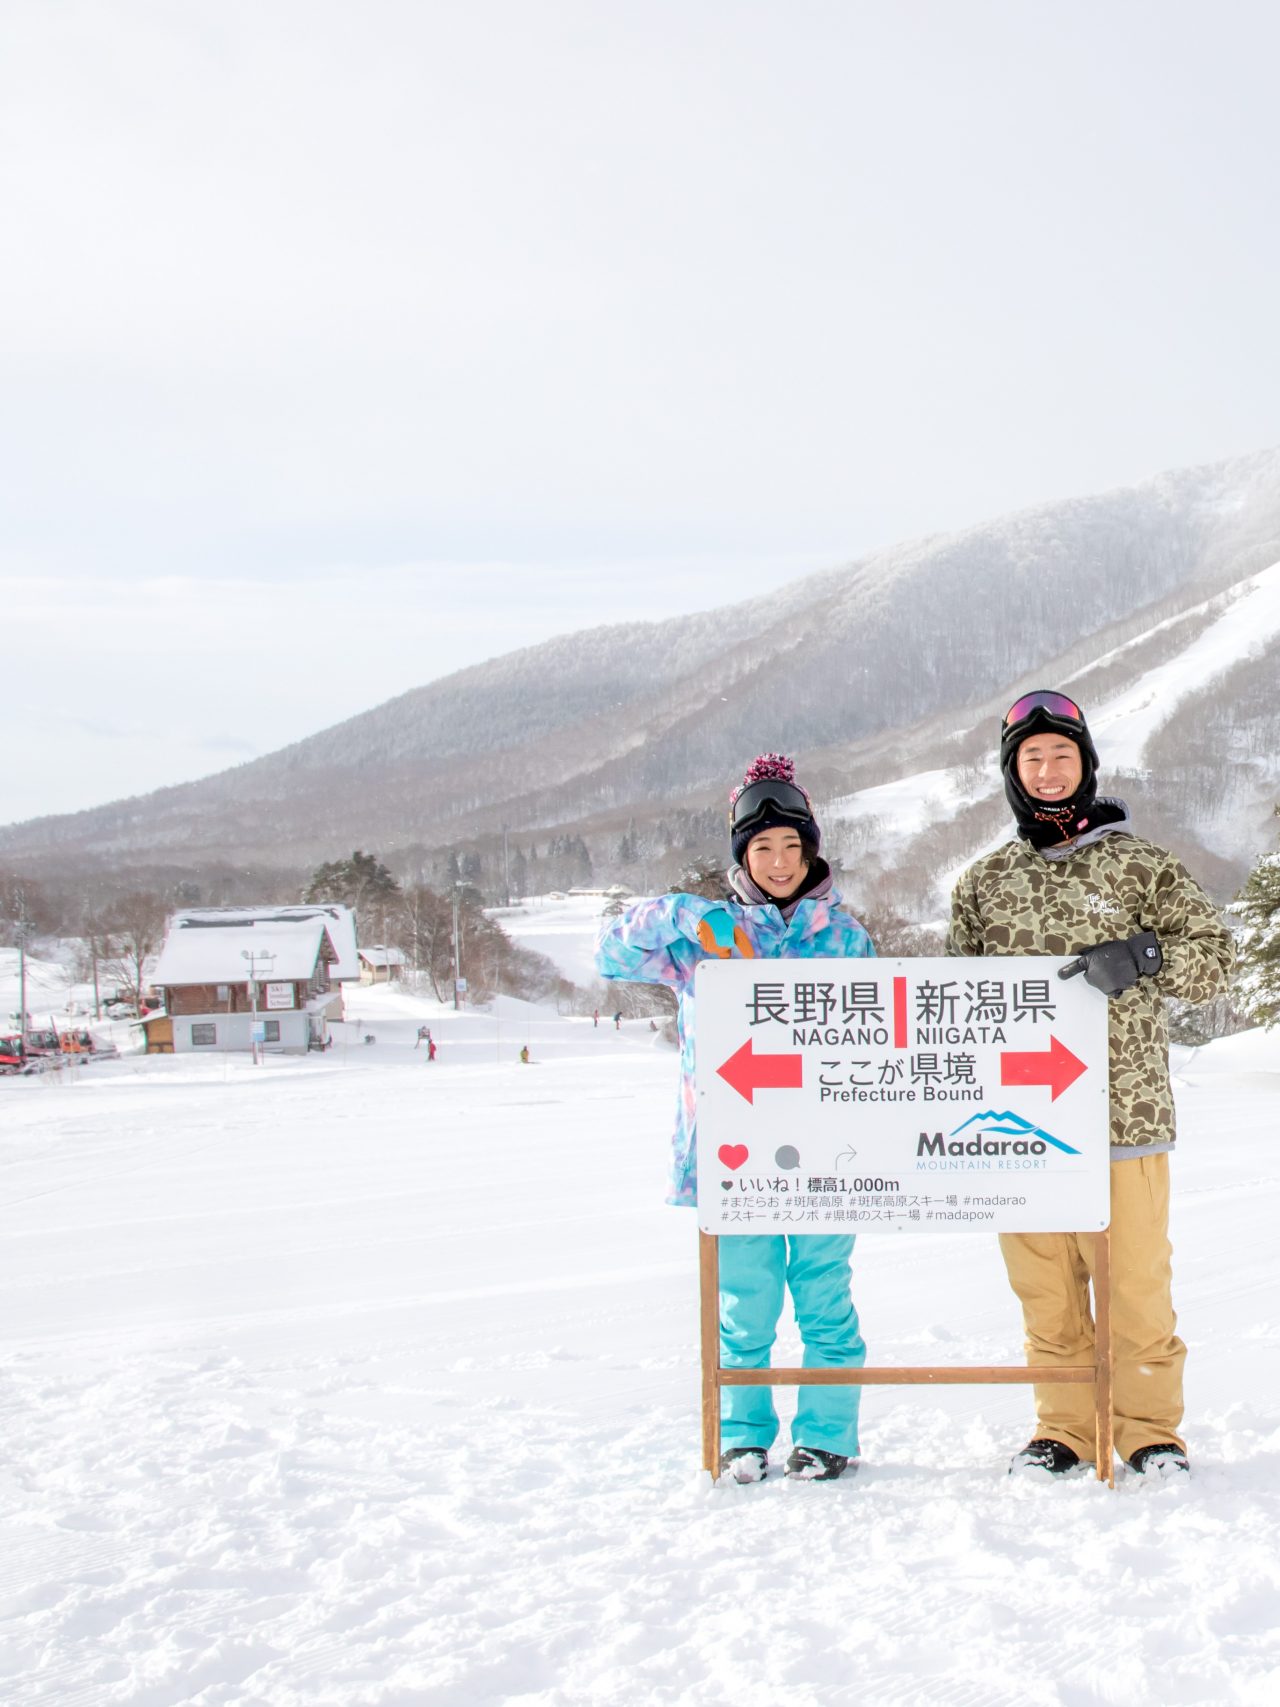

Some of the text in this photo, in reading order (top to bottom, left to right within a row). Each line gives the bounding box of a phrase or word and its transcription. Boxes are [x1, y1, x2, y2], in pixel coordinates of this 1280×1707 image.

[745, 982, 885, 1026] 長野県
[916, 980, 1056, 1025] 新潟県
[792, 1028, 889, 1046] NAGANO
[916, 1026, 1007, 1044] NIIGATA
[818, 1052, 976, 1086] ここが県境
[820, 1085, 984, 1102] Prefecture Bound
[916, 1132, 1047, 1157] Madarao
[916, 1159, 1047, 1170] MOUNTAIN RESORT
[964, 1194, 1027, 1207] #madarao
[721, 1210, 767, 1222] #スキー
[926, 1209, 995, 1222] #madapow
